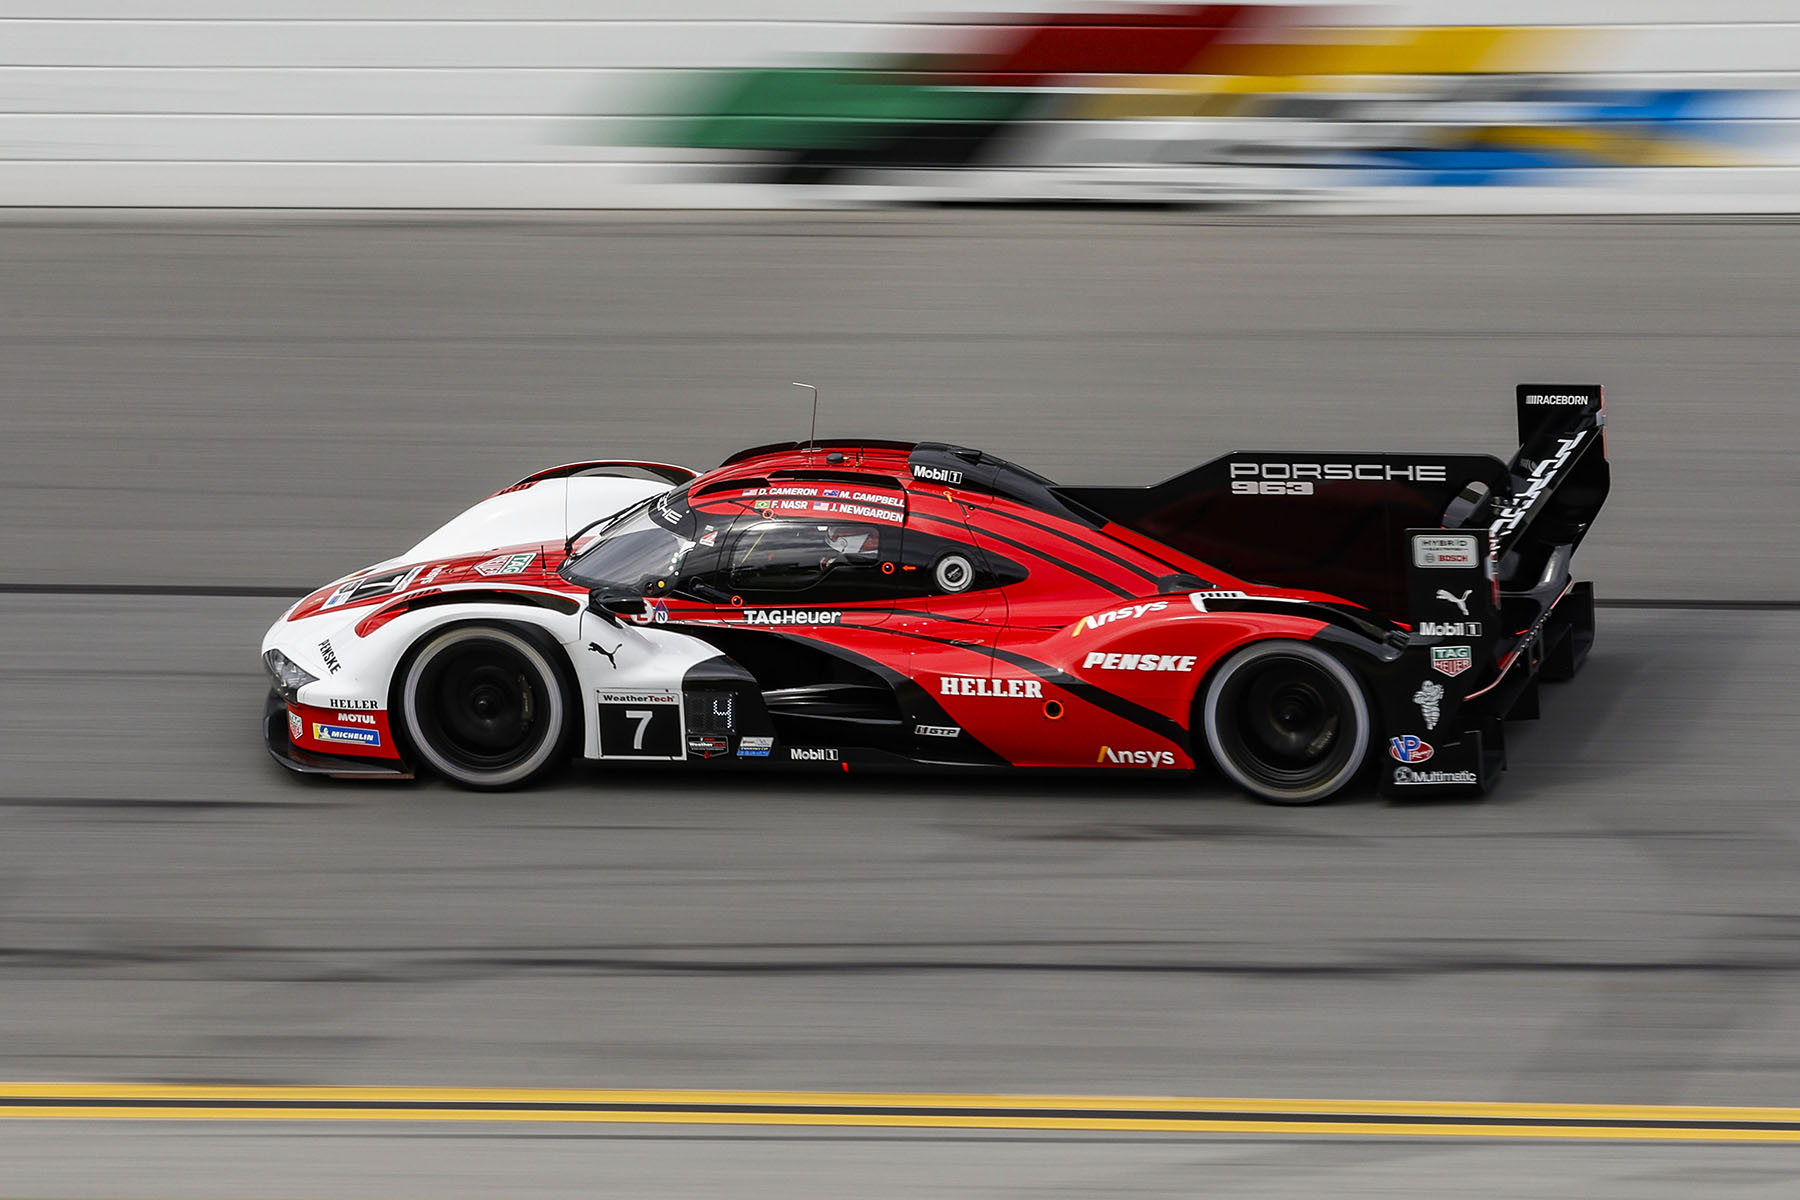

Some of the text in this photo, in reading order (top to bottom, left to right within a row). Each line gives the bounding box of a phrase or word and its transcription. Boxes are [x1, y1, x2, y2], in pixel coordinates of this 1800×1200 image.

[1536, 395, 1589, 405] RACEBORN
[914, 465, 949, 482] Mobil
[1230, 463, 1447, 482] PORSCHE
[758, 487, 819, 496] D. CAMERON
[1231, 481, 1315, 495] 963
[771, 501, 808, 510] F. NASR
[839, 491, 852, 499] M.
[852, 491, 905, 508] CAMPBELL
[829, 503, 904, 522] J. NEWGARDEN
[1437, 554, 1469, 562] BOSCH
[1072, 601, 1169, 637] Ansys
[1419, 622, 1465, 636] Mobil
[318, 639, 342, 675] PENSKE
[1435, 648, 1469, 659] TAG
[1082, 652, 1198, 672] PENSKE
[940, 677, 1043, 698] HELLER
[330, 699, 378, 709] HELLER
[603, 694, 675, 703] WeatherTech
[338, 713, 376, 725] MOTUL
[331, 730, 374, 741] MICHELIN
[625, 710, 653, 750] 7
[790, 749, 825, 760] Mobil
[1390, 735, 1421, 762] VP
[1097, 746, 1175, 767] Ansys
[1414, 771, 1477, 783] Multimatic
